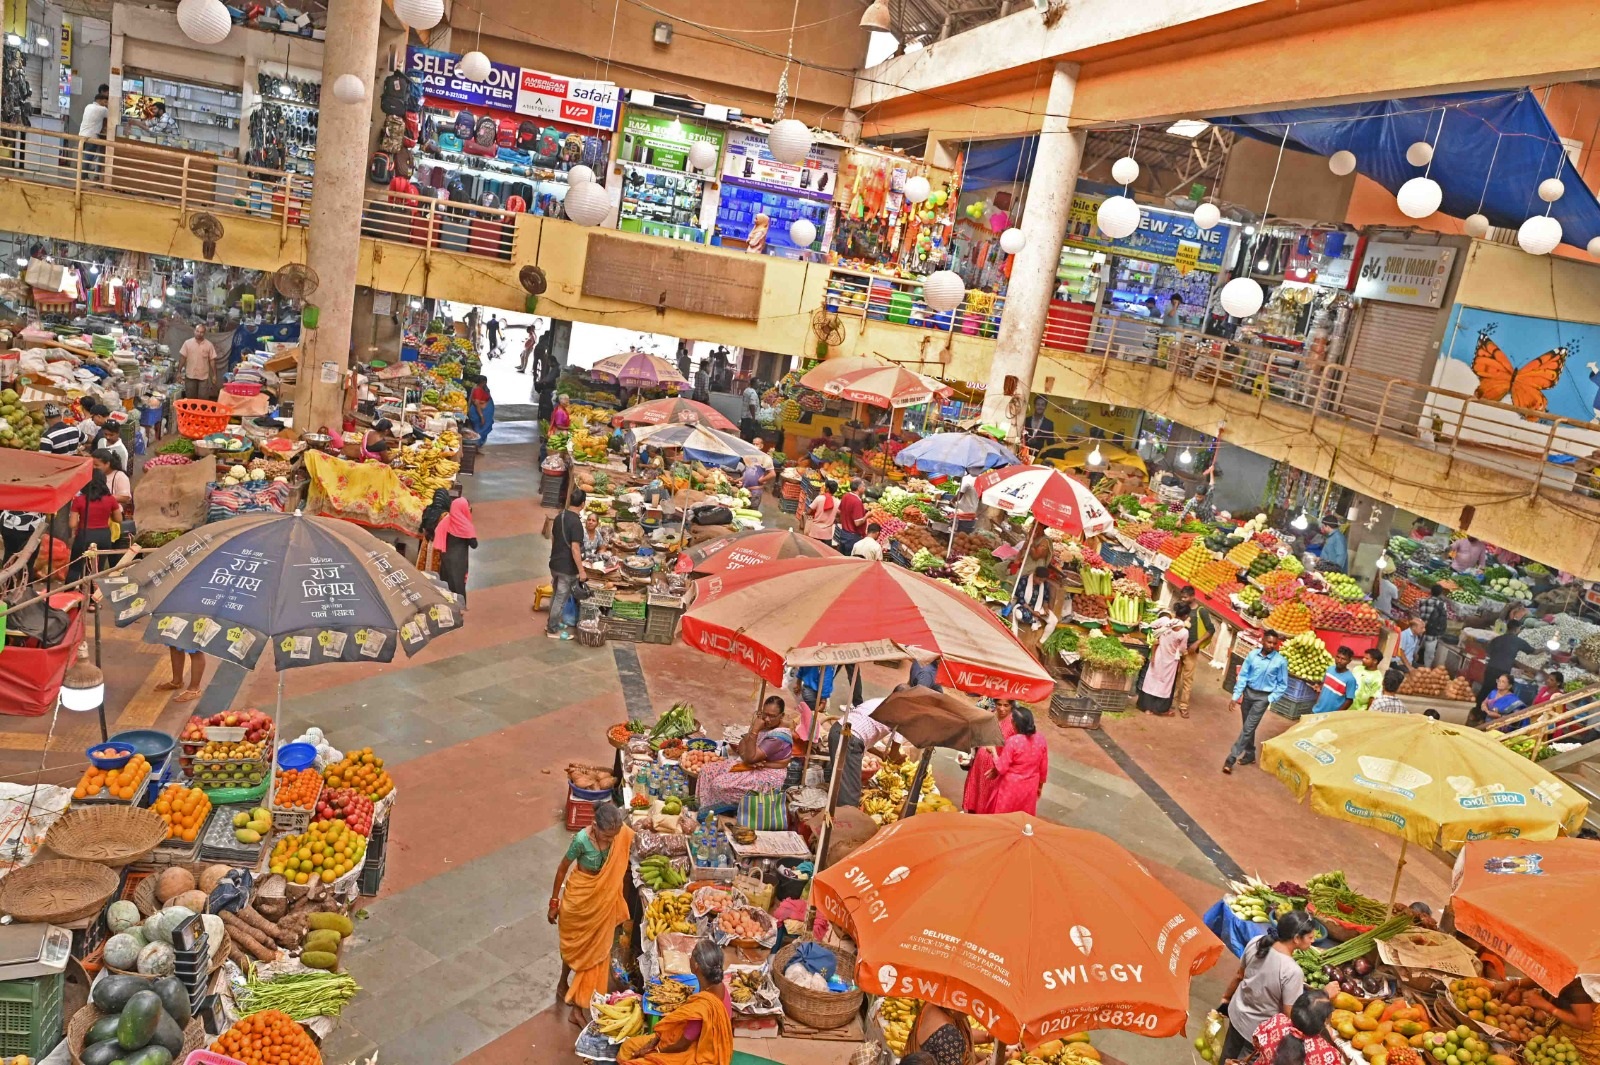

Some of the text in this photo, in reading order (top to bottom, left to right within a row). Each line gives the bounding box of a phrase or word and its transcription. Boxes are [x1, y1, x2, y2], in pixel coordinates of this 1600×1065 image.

[413, 52, 516, 90] SELECON
[422, 74, 514, 100] AG CENTER
[524, 82, 565, 94] TOURISTER
[525, 77, 566, 89] AMERICAN
[573, 88, 612, 104] safari
[565, 105, 588, 117] VIP
[628, 120, 651, 132] RAZA
[688, 133, 718, 145] STORE
[1139, 218, 1221, 244] EW ZONE
[1176, 258, 1195, 266] REPAIR
[1178, 252, 1196, 260] MOBILE
[230, 558, 261, 573] राज
[374, 558, 392, 572] राज
[728, 552, 763, 565] FASHIO
[208, 568, 263, 592] निवास
[309, 567, 340, 580] राज
[302, 580, 355, 597] निवास
[700, 630, 772, 671] INDIRA IVF
[956, 671, 1031, 694] INDIRA IVF
[845, 866, 888, 923] SWIGGY
[923, 929, 1005, 964] DELIVERY JOB IN GOA
[982, 958, 1010, 977] PARTNER
[992, 973, 1011, 987] MONTH
[1043, 964, 1143, 990] SWIGGY
[900, 976, 1000, 1029] SWIGGY
